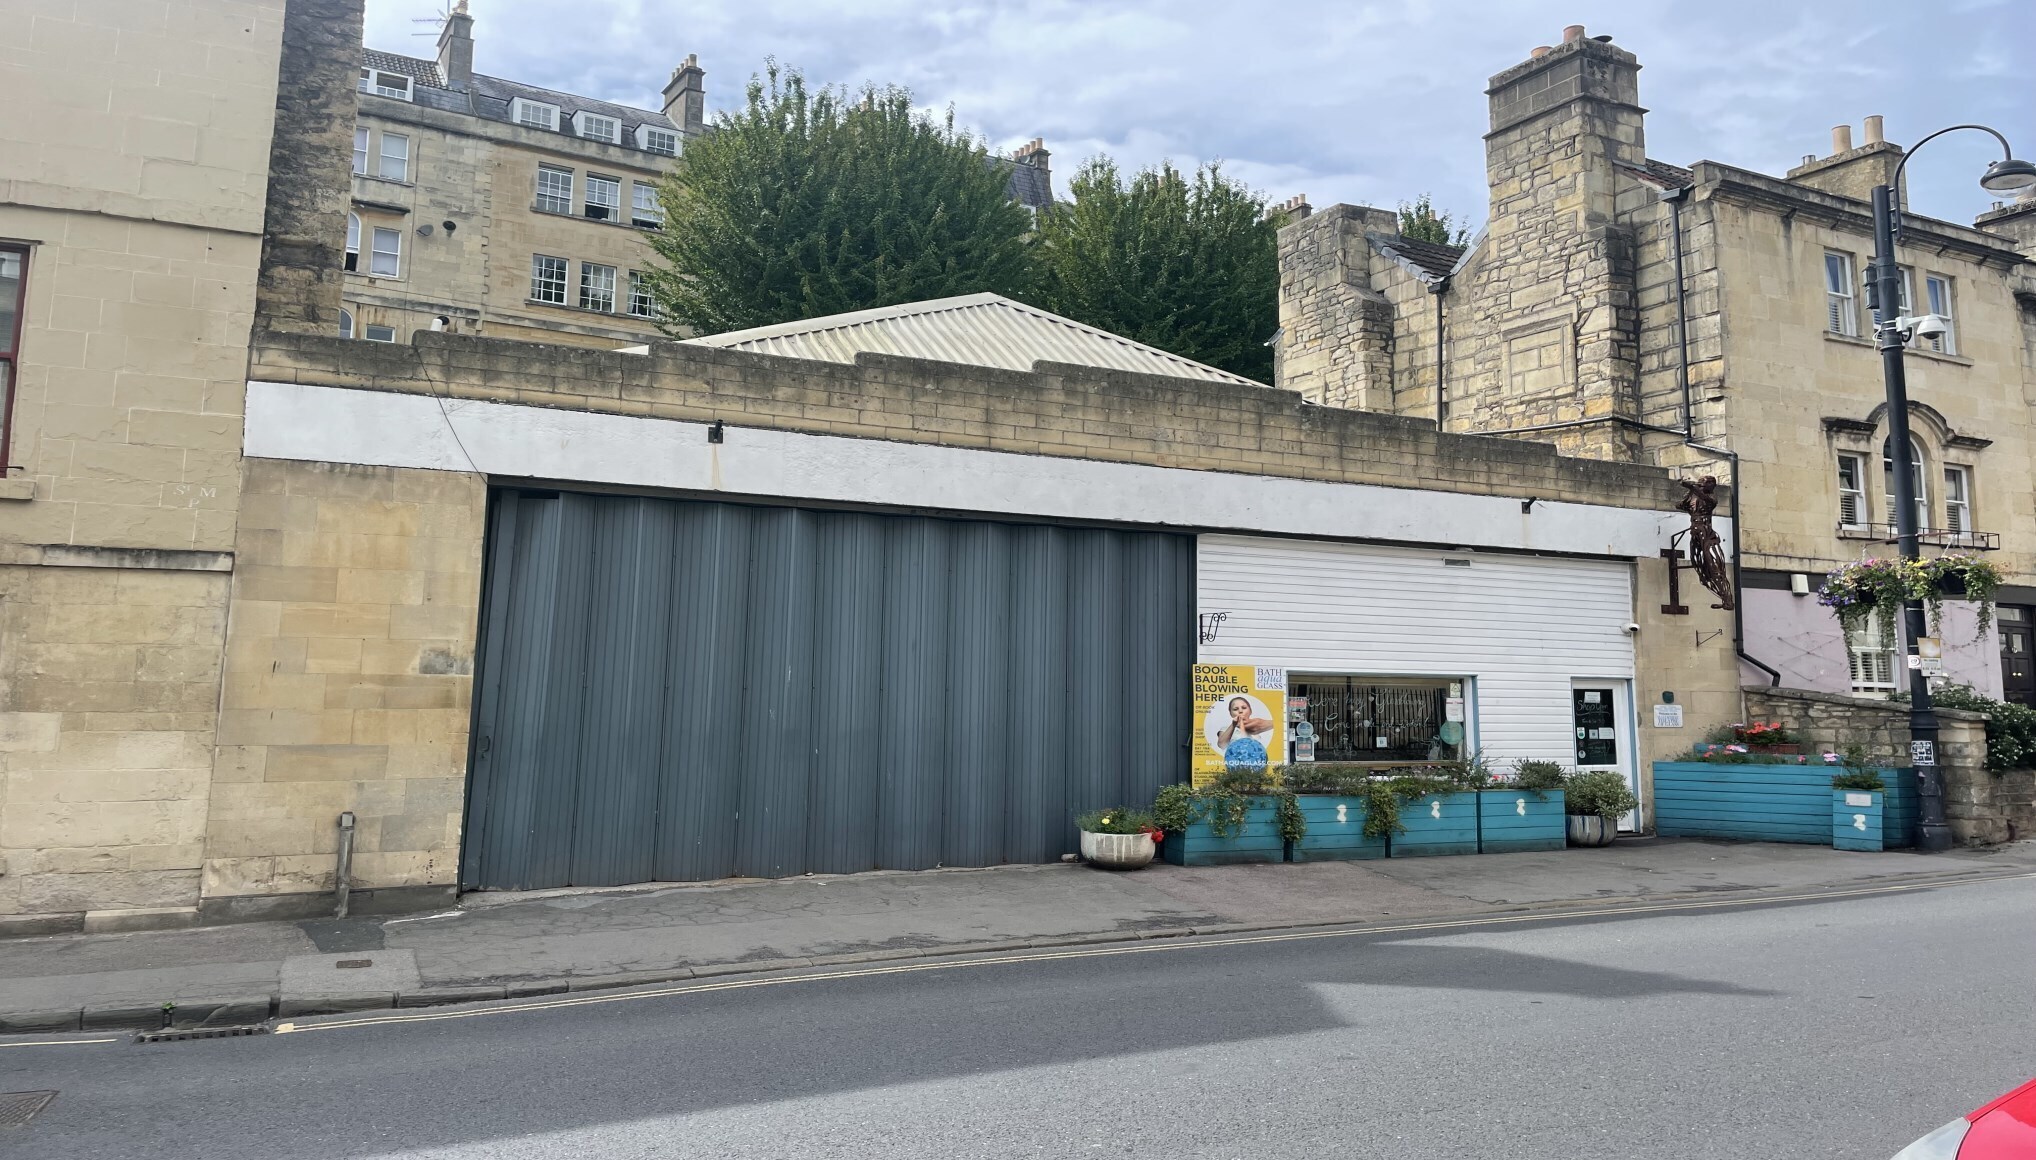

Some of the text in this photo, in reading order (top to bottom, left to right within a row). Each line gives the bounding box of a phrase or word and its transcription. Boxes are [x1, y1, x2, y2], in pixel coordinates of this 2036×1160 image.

[200, 487, 217, 498] M
[1194, 665, 1228, 675] BOOK
[1257, 668, 1282, 677] BATH
[1194, 675, 1238, 685] BAUBLE
[1195, 684, 1249, 694] BLOWING
[1195, 693, 1225, 702] HERE
